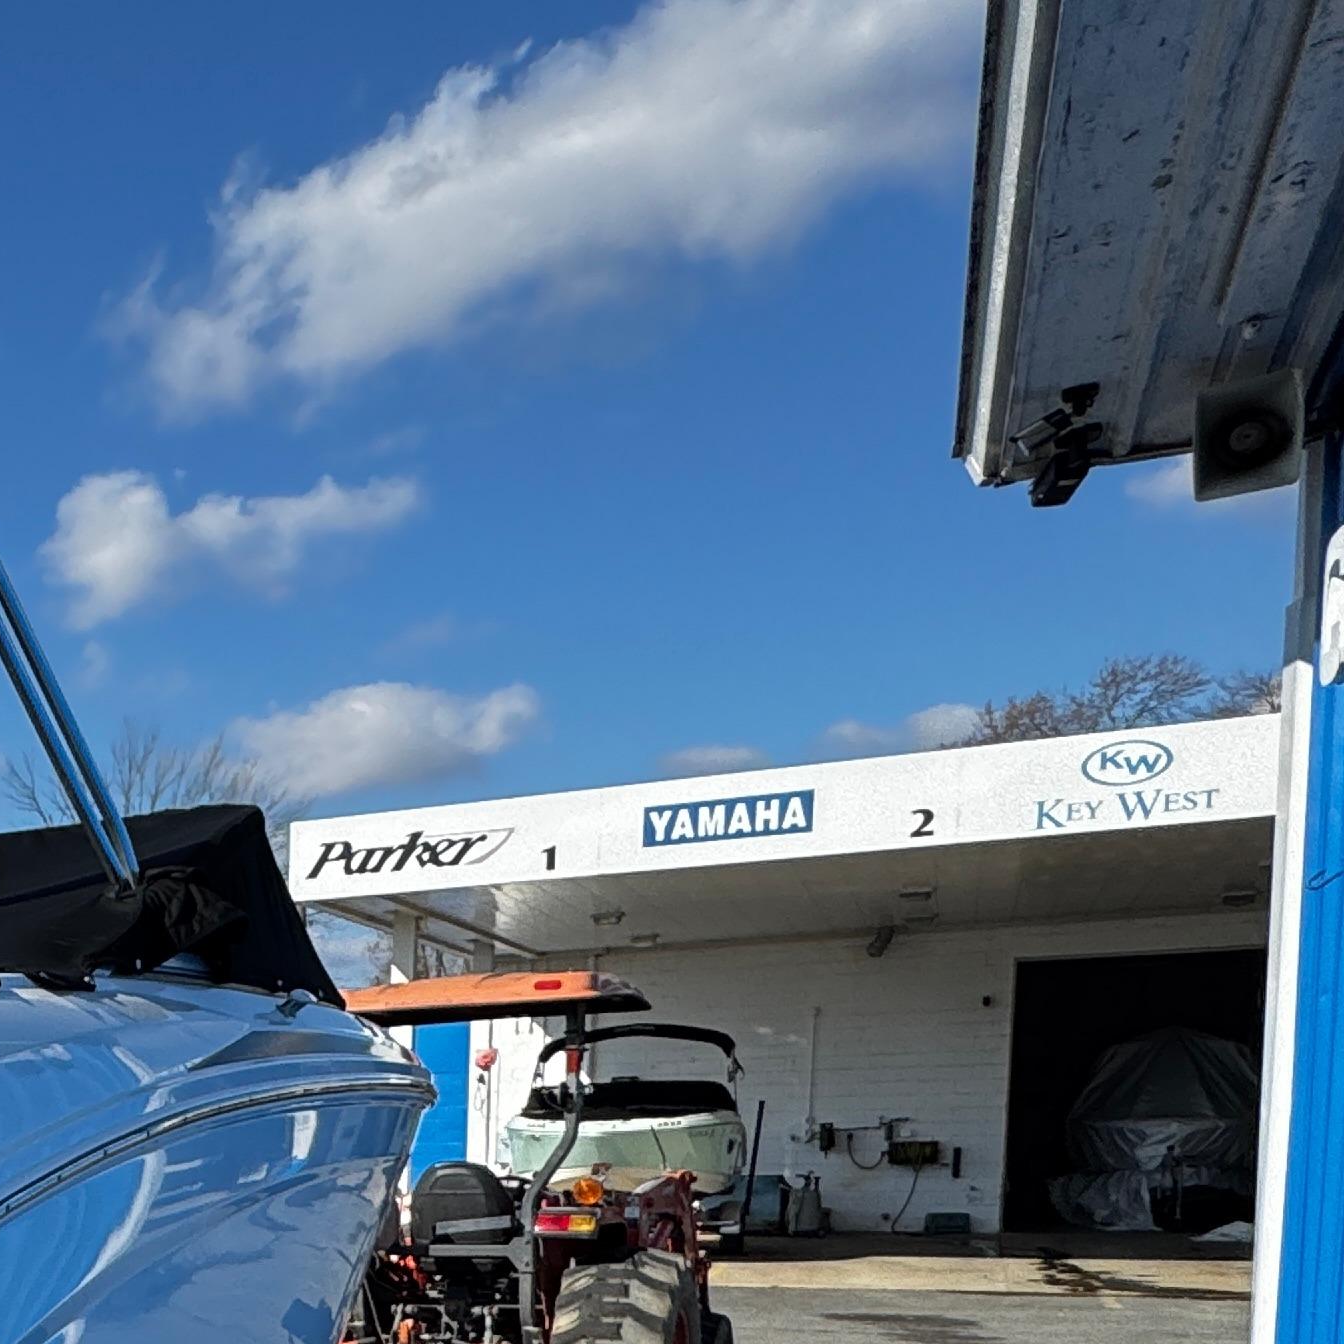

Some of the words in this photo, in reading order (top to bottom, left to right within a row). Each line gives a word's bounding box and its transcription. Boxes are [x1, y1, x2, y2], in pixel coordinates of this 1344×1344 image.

[1098, 749, 1163, 775] KW
[648, 796, 807, 842] YAMAHA
[910, 808, 935, 838] 2
[1034, 798, 1104, 830] KEY
[1116, 788, 1220, 821] WEST
[305, 830, 488, 880] Parker
[541, 845, 557, 870] 1
